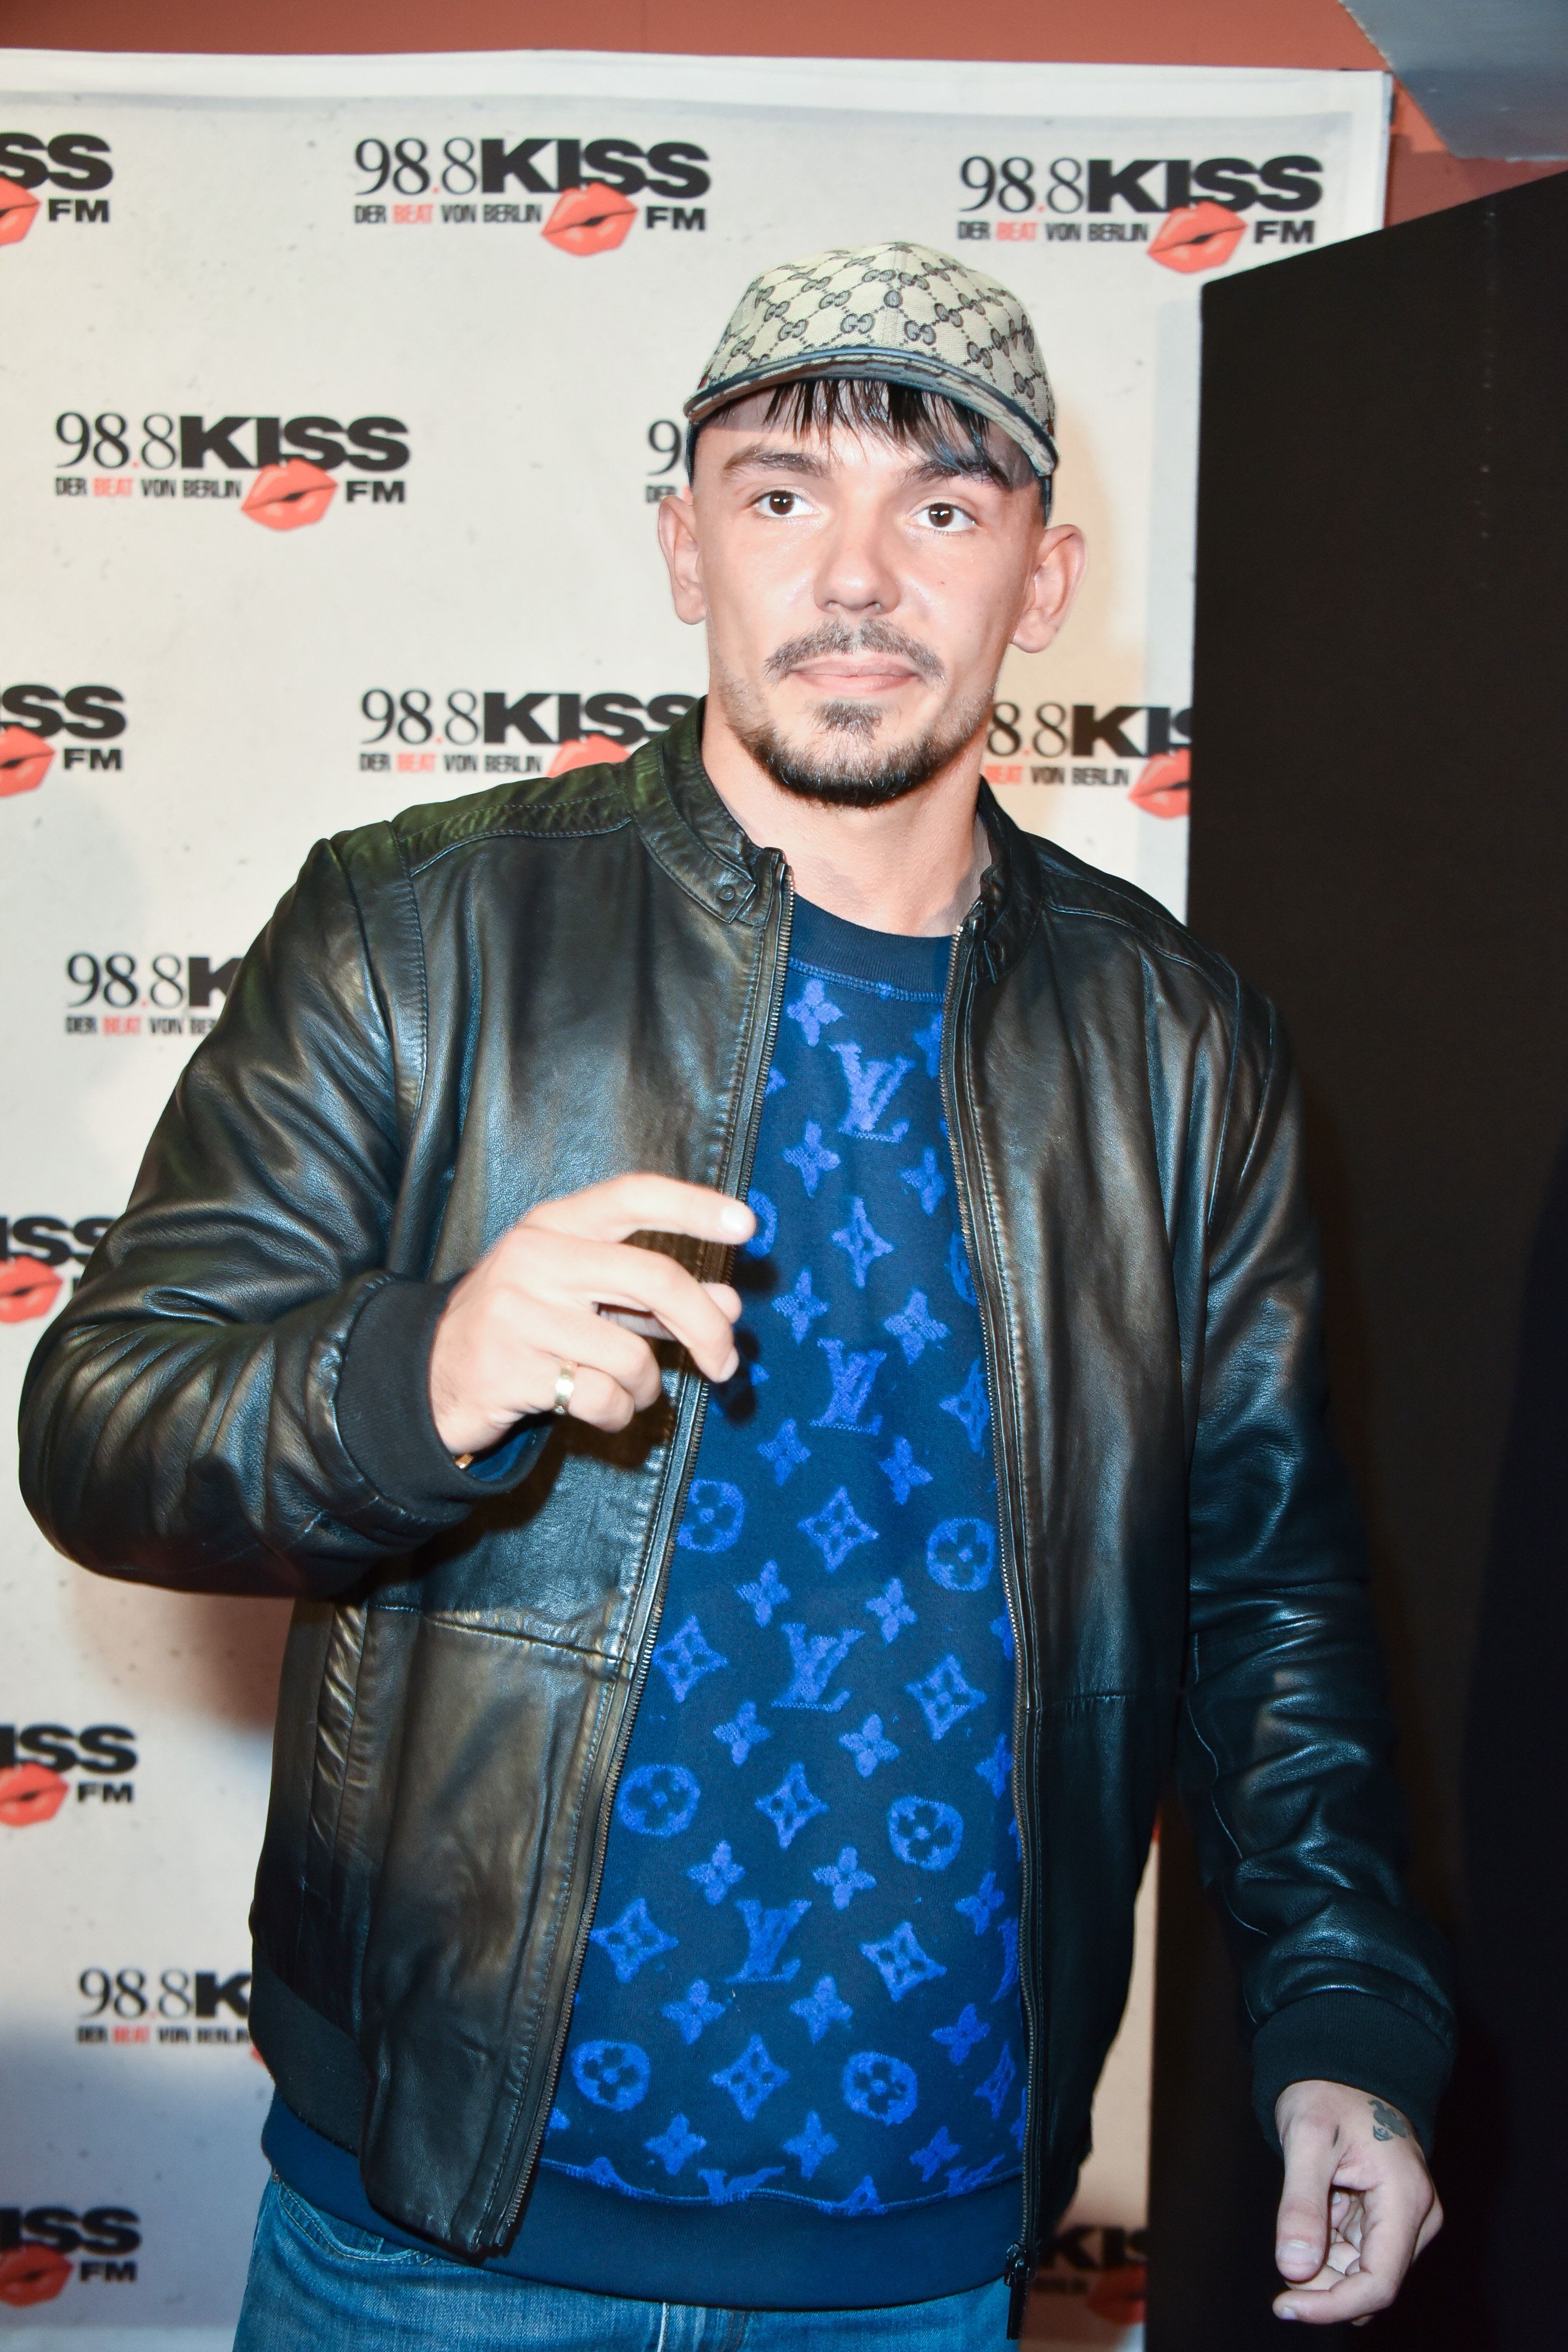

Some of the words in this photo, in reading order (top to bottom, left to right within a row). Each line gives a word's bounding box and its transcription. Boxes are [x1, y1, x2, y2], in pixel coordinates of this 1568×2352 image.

[355, 137, 478, 195] 98.8
[480, 138, 712, 199] KISS
[960, 155, 1084, 214] 98.8
[1086, 154, 1323, 213] KISS
[48, 198, 110, 223] FM
[354, 204, 387, 224] DER
[393, 203, 433, 224] BEAT
[440, 203, 477, 223] VON
[482, 203, 542, 223] BERLIN
[645, 206, 706, 231] FM
[957, 220, 990, 240] DER
[996, 221, 1038, 242] BEAT
[1045, 222, 1082, 242] VON
[1087, 222, 1149, 242] BERLIN
[1253, 219, 1315, 244] FM
[55, 412, 177, 469] 98.8
[179, 415, 410, 470] KISS
[55, 476, 87, 496] DER
[93, 477, 133, 497] BEAT
[141, 478, 176, 497] VON
[182, 479, 241, 498] BERLIN
[345, 480, 405, 503] FM
[361, 689, 479, 744] 98.8
[63, 747, 122, 770] FM
[359, 753, 390, 771] DER
[396, 753, 436, 772] BEAT
[443, 754, 478, 772] VON
[484, 754, 541, 774] BERLIN
[66, 952, 184, 1008] 98.8
[76, 1782, 134, 1803] FM
[79, 1969, 190, 2018] 98.8
[79, 2260, 138, 2283] FM
